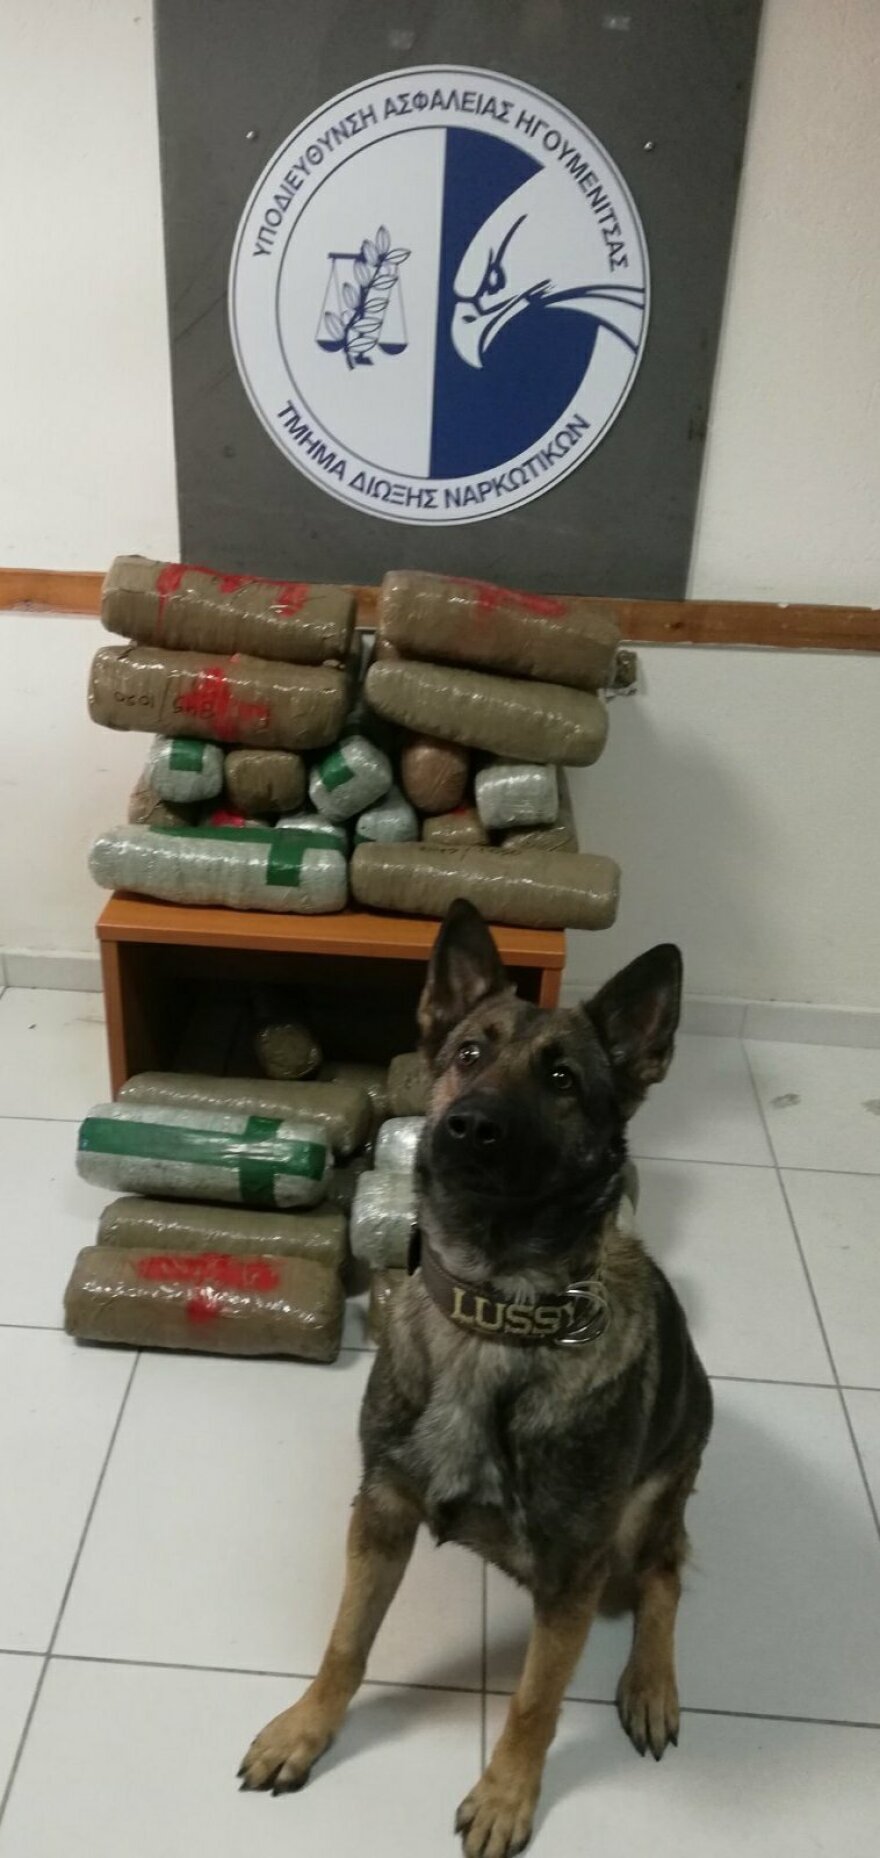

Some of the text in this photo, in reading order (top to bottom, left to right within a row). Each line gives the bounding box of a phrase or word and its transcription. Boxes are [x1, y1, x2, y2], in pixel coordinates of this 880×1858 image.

[253, 88, 629, 271] ΥΠΟΔΙΕΥΘΥΝΣΗ ΑΣΦΑΛΕΙΑΣ ΗΓΟΥΜΕΝΙΤΣΑΣ
[276, 400, 591, 509] ΤΜΗΜΑ ΔΙΩΞΗΣ ΝΑΡΚΩΤΙΚΩΝ
